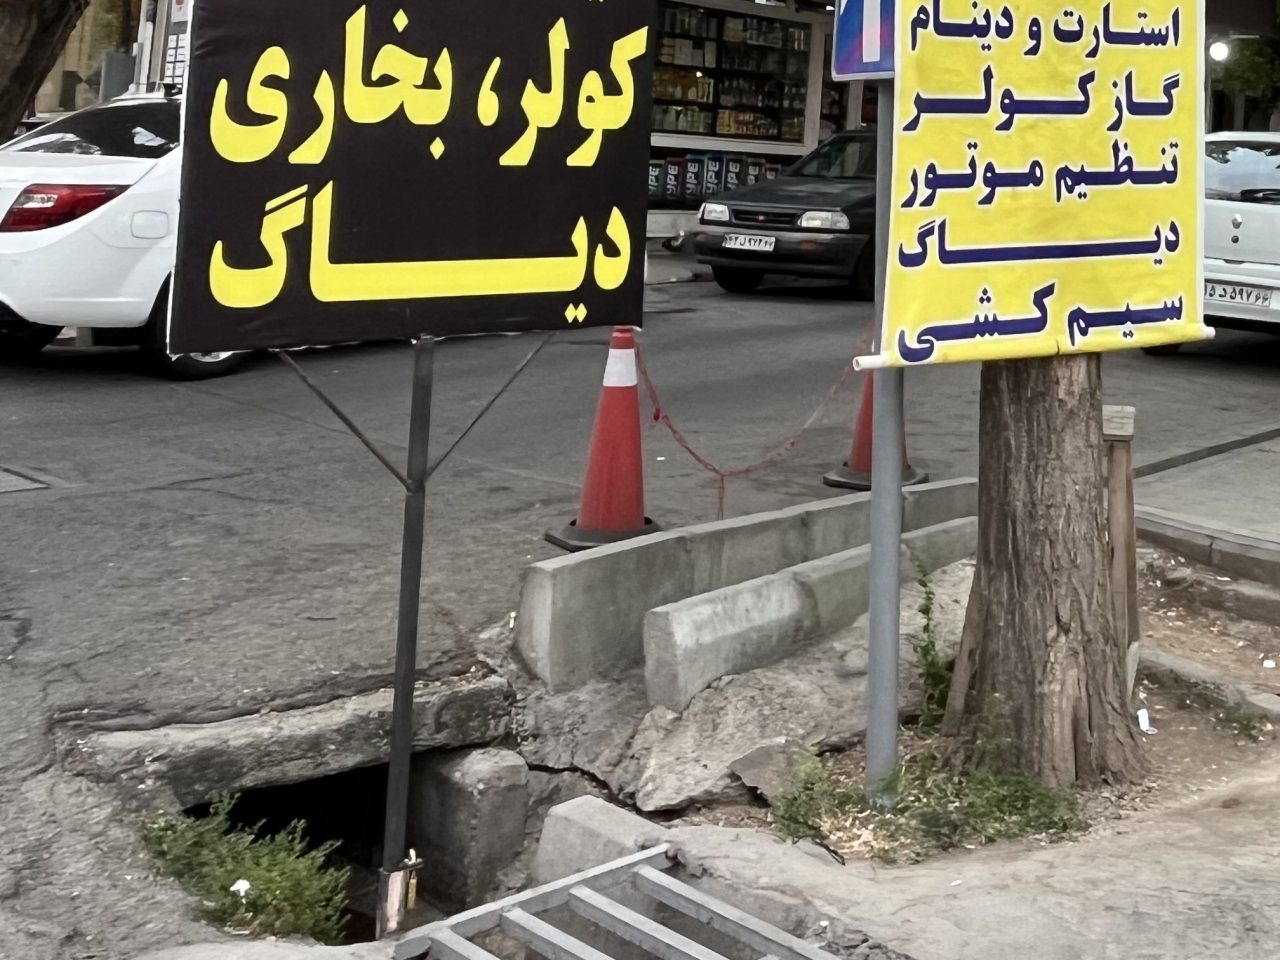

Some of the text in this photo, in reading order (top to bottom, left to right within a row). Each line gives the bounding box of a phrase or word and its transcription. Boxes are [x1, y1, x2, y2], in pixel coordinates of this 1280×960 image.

[1025, 17, 1042, 56] و
[1053, 2, 1180, 58] استارت
[210, 5, 453, 164] بخاری
[902, 64, 1180, 132] گاز کولر
[900, 138, 1179, 208] تنظیم موتور
[209, 180, 631, 323] دیاگ
[898, 219, 1180, 269] دیاگ
[899, 283, 1183, 363] سیم کشی
